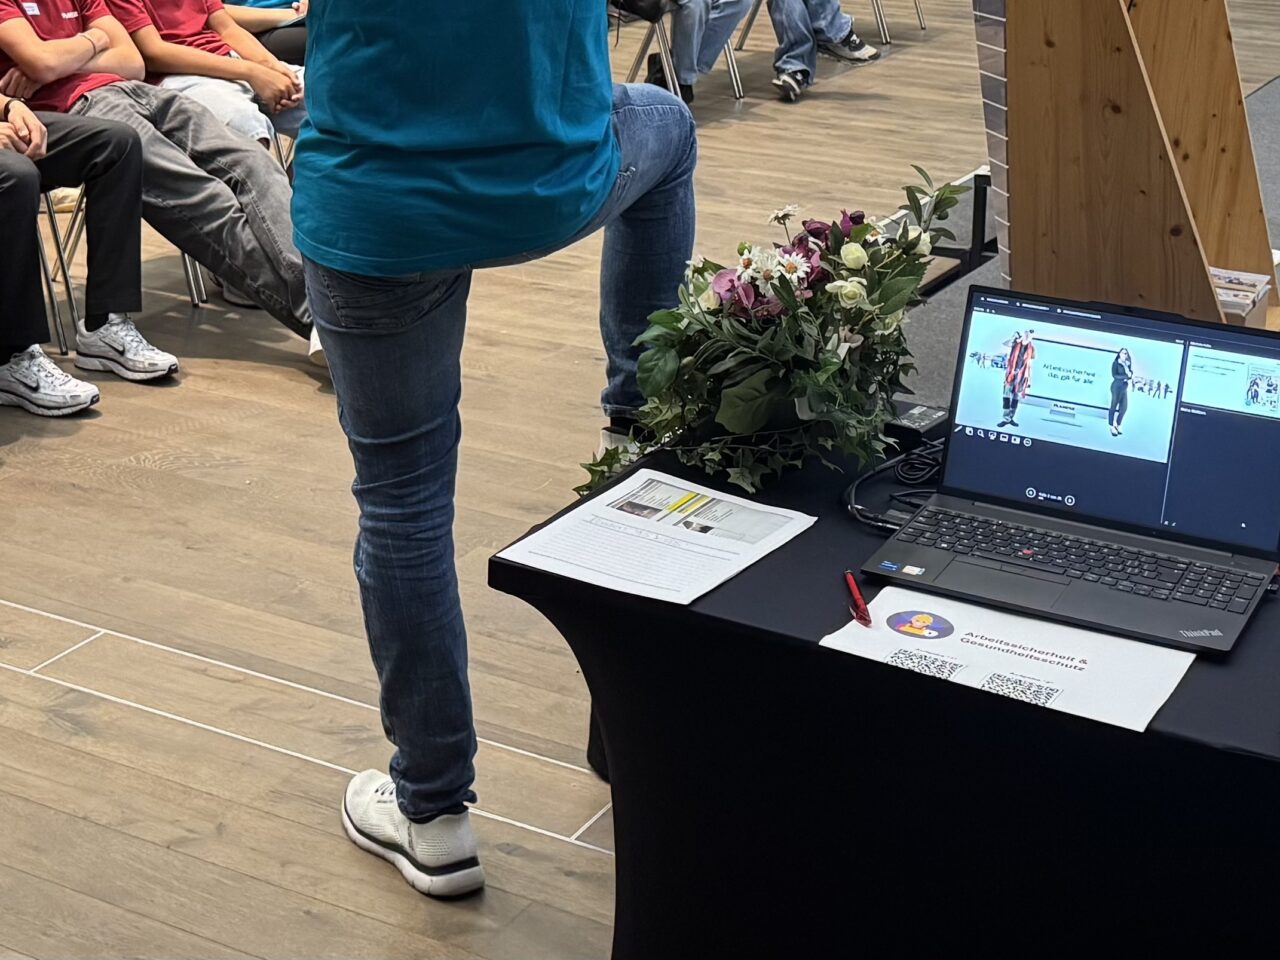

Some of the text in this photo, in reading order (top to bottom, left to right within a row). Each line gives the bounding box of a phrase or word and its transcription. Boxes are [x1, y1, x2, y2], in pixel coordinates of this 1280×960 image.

[964, 631, 1077, 665] Arbeitssicherheit
[1179, 629, 1224, 638] ThinkPad
[960, 637, 1087, 672] Gesundheitsschutz
